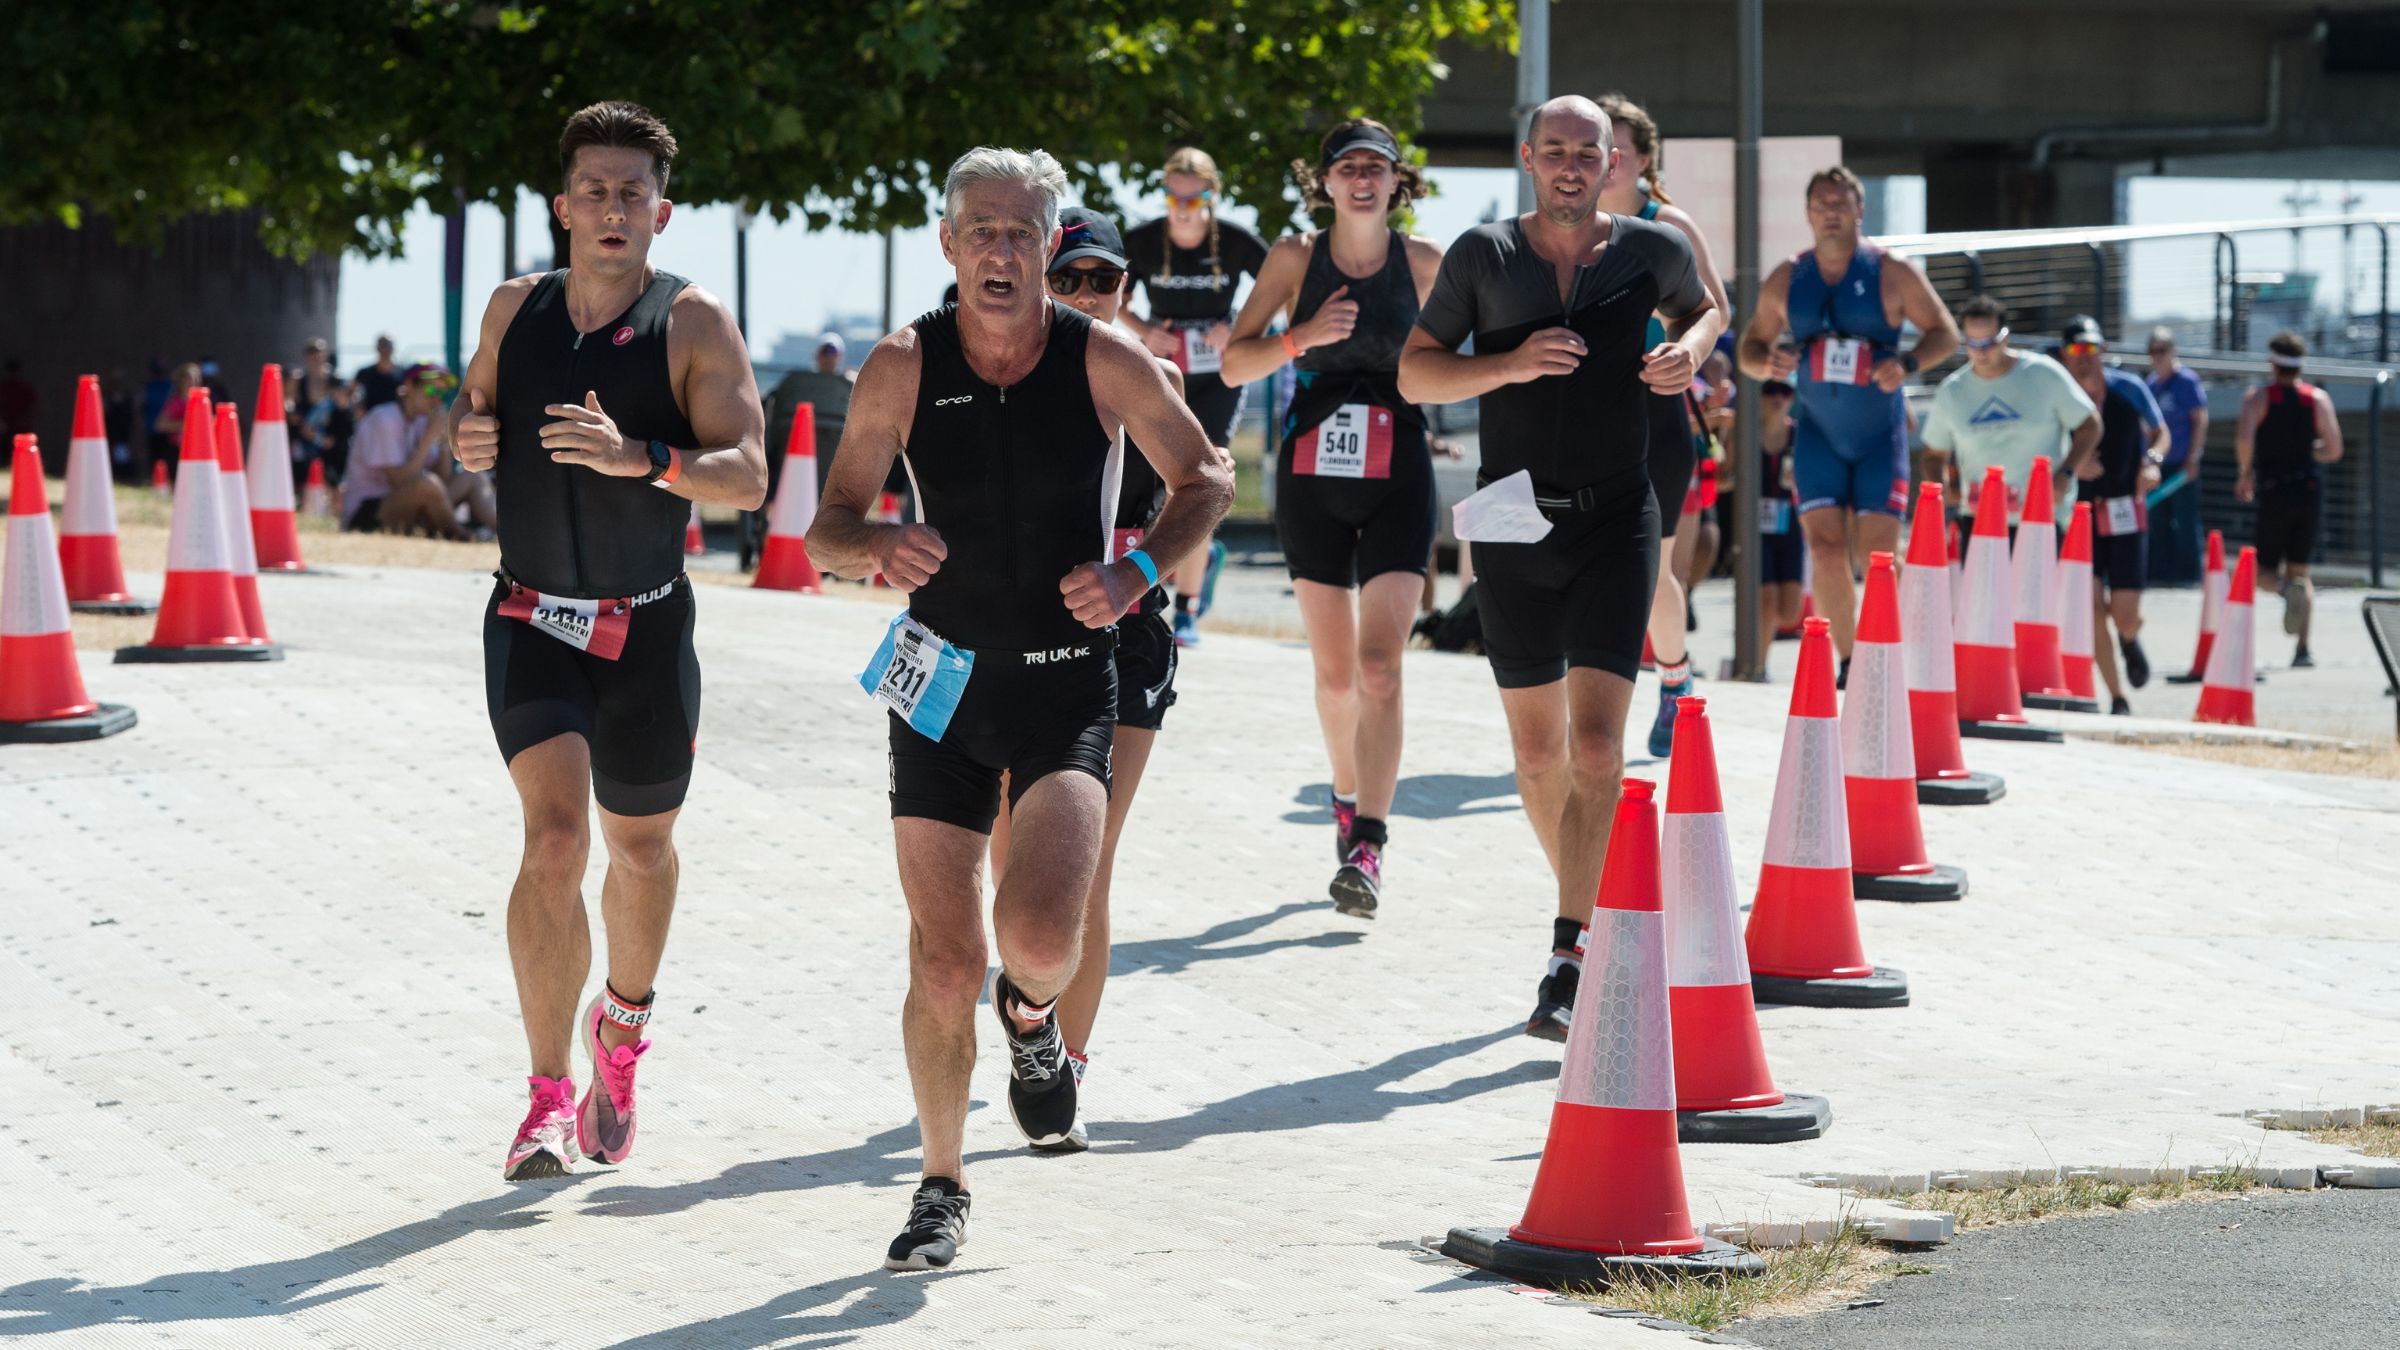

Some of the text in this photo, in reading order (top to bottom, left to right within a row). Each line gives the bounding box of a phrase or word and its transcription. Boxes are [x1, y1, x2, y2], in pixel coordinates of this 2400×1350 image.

[1325, 431, 1358, 455] 540
[631, 582, 673, 609] HUUB
[1023, 650, 1046, 665] TRI
[1049, 646, 1072, 662] UK
